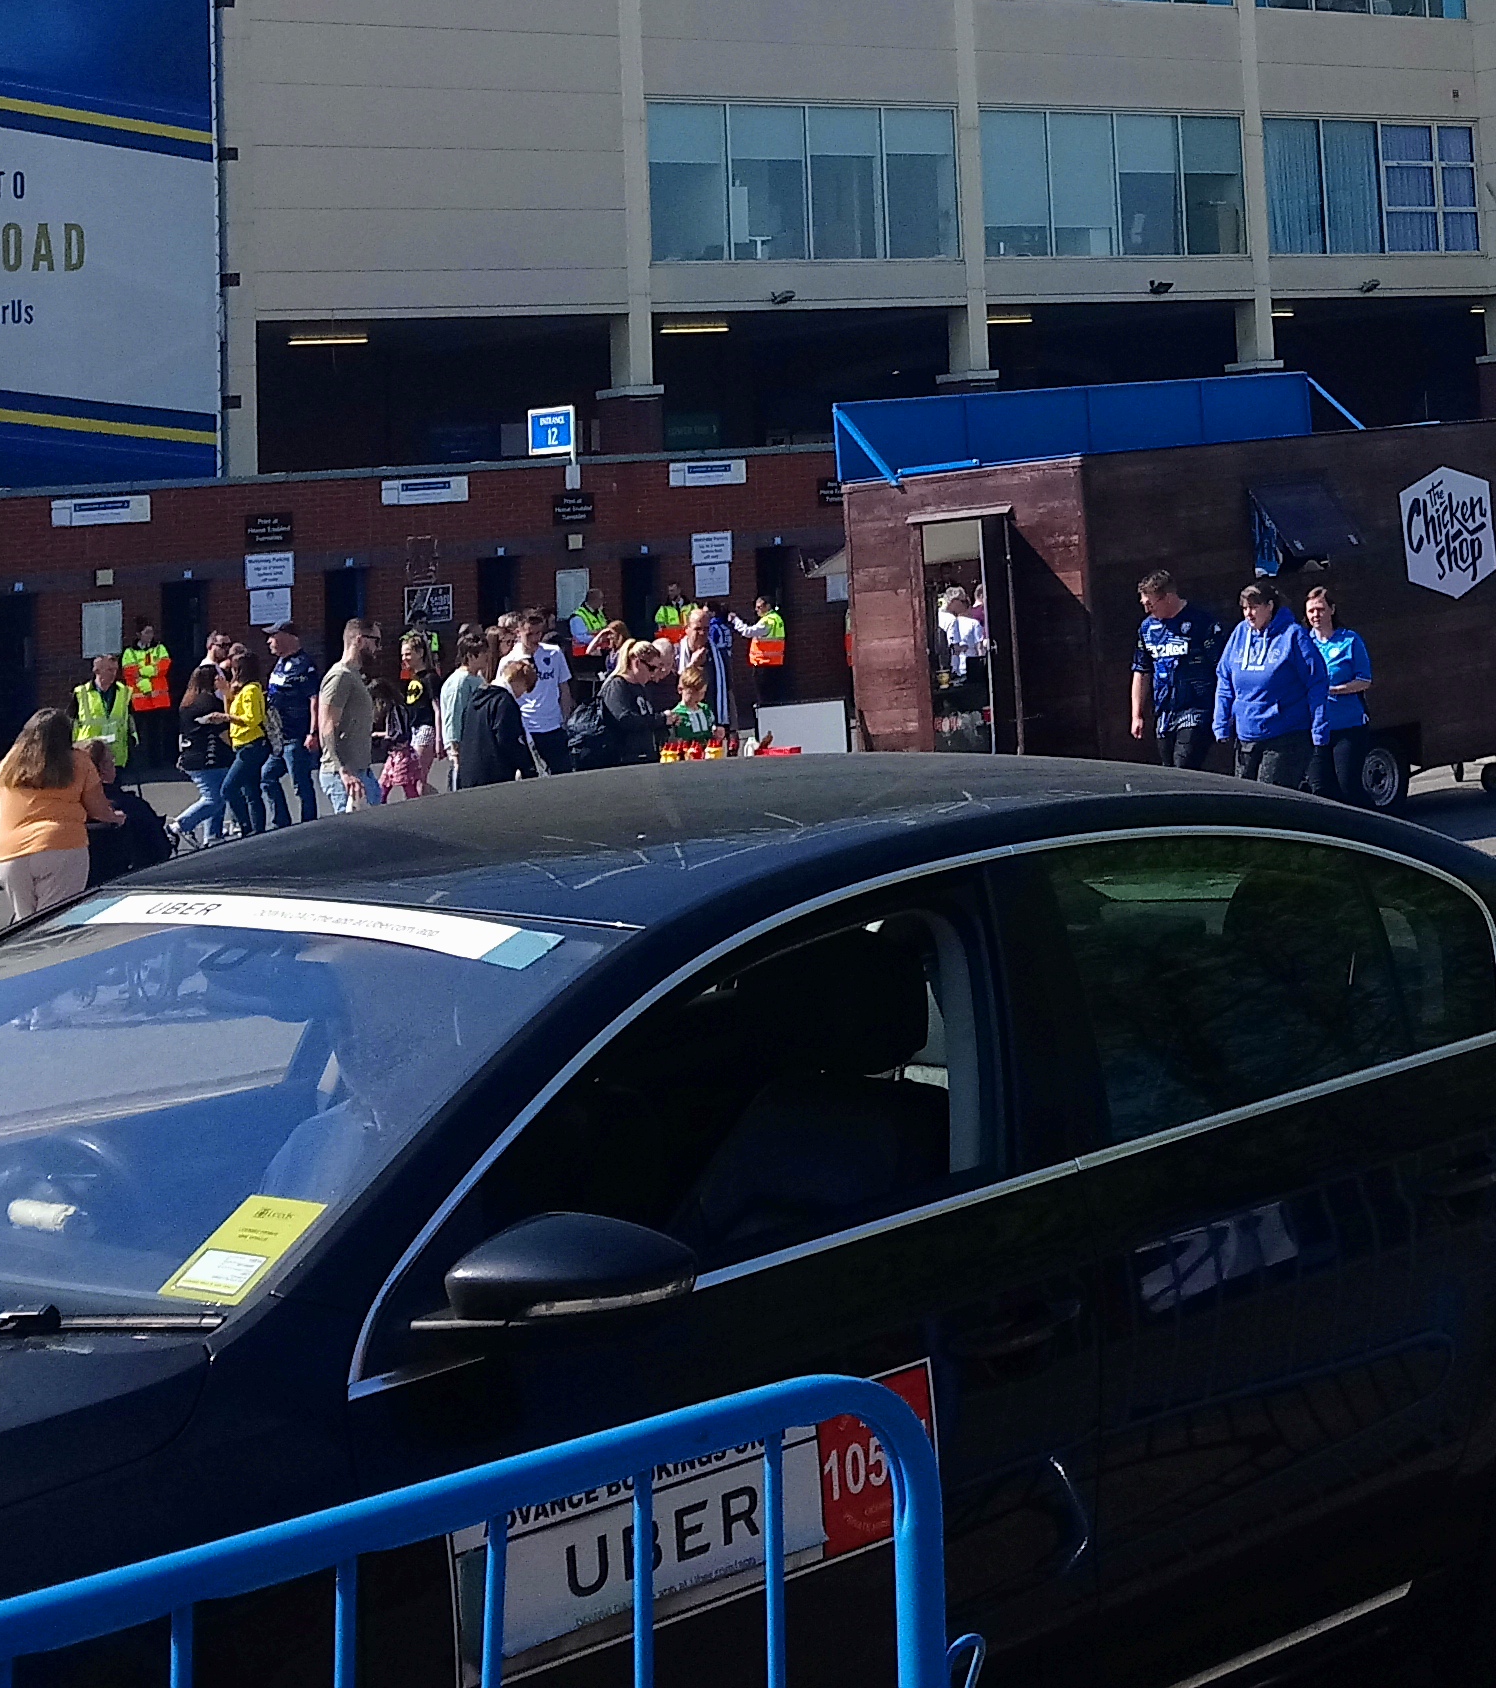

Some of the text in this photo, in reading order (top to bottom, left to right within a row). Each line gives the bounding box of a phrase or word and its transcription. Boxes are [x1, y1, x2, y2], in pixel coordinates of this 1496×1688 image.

[547, 427, 559, 445] 12
[1406, 492, 1487, 554] Chicken
[145, 902, 222, 916] UBER
[566, 1486, 760, 1598] UBER
